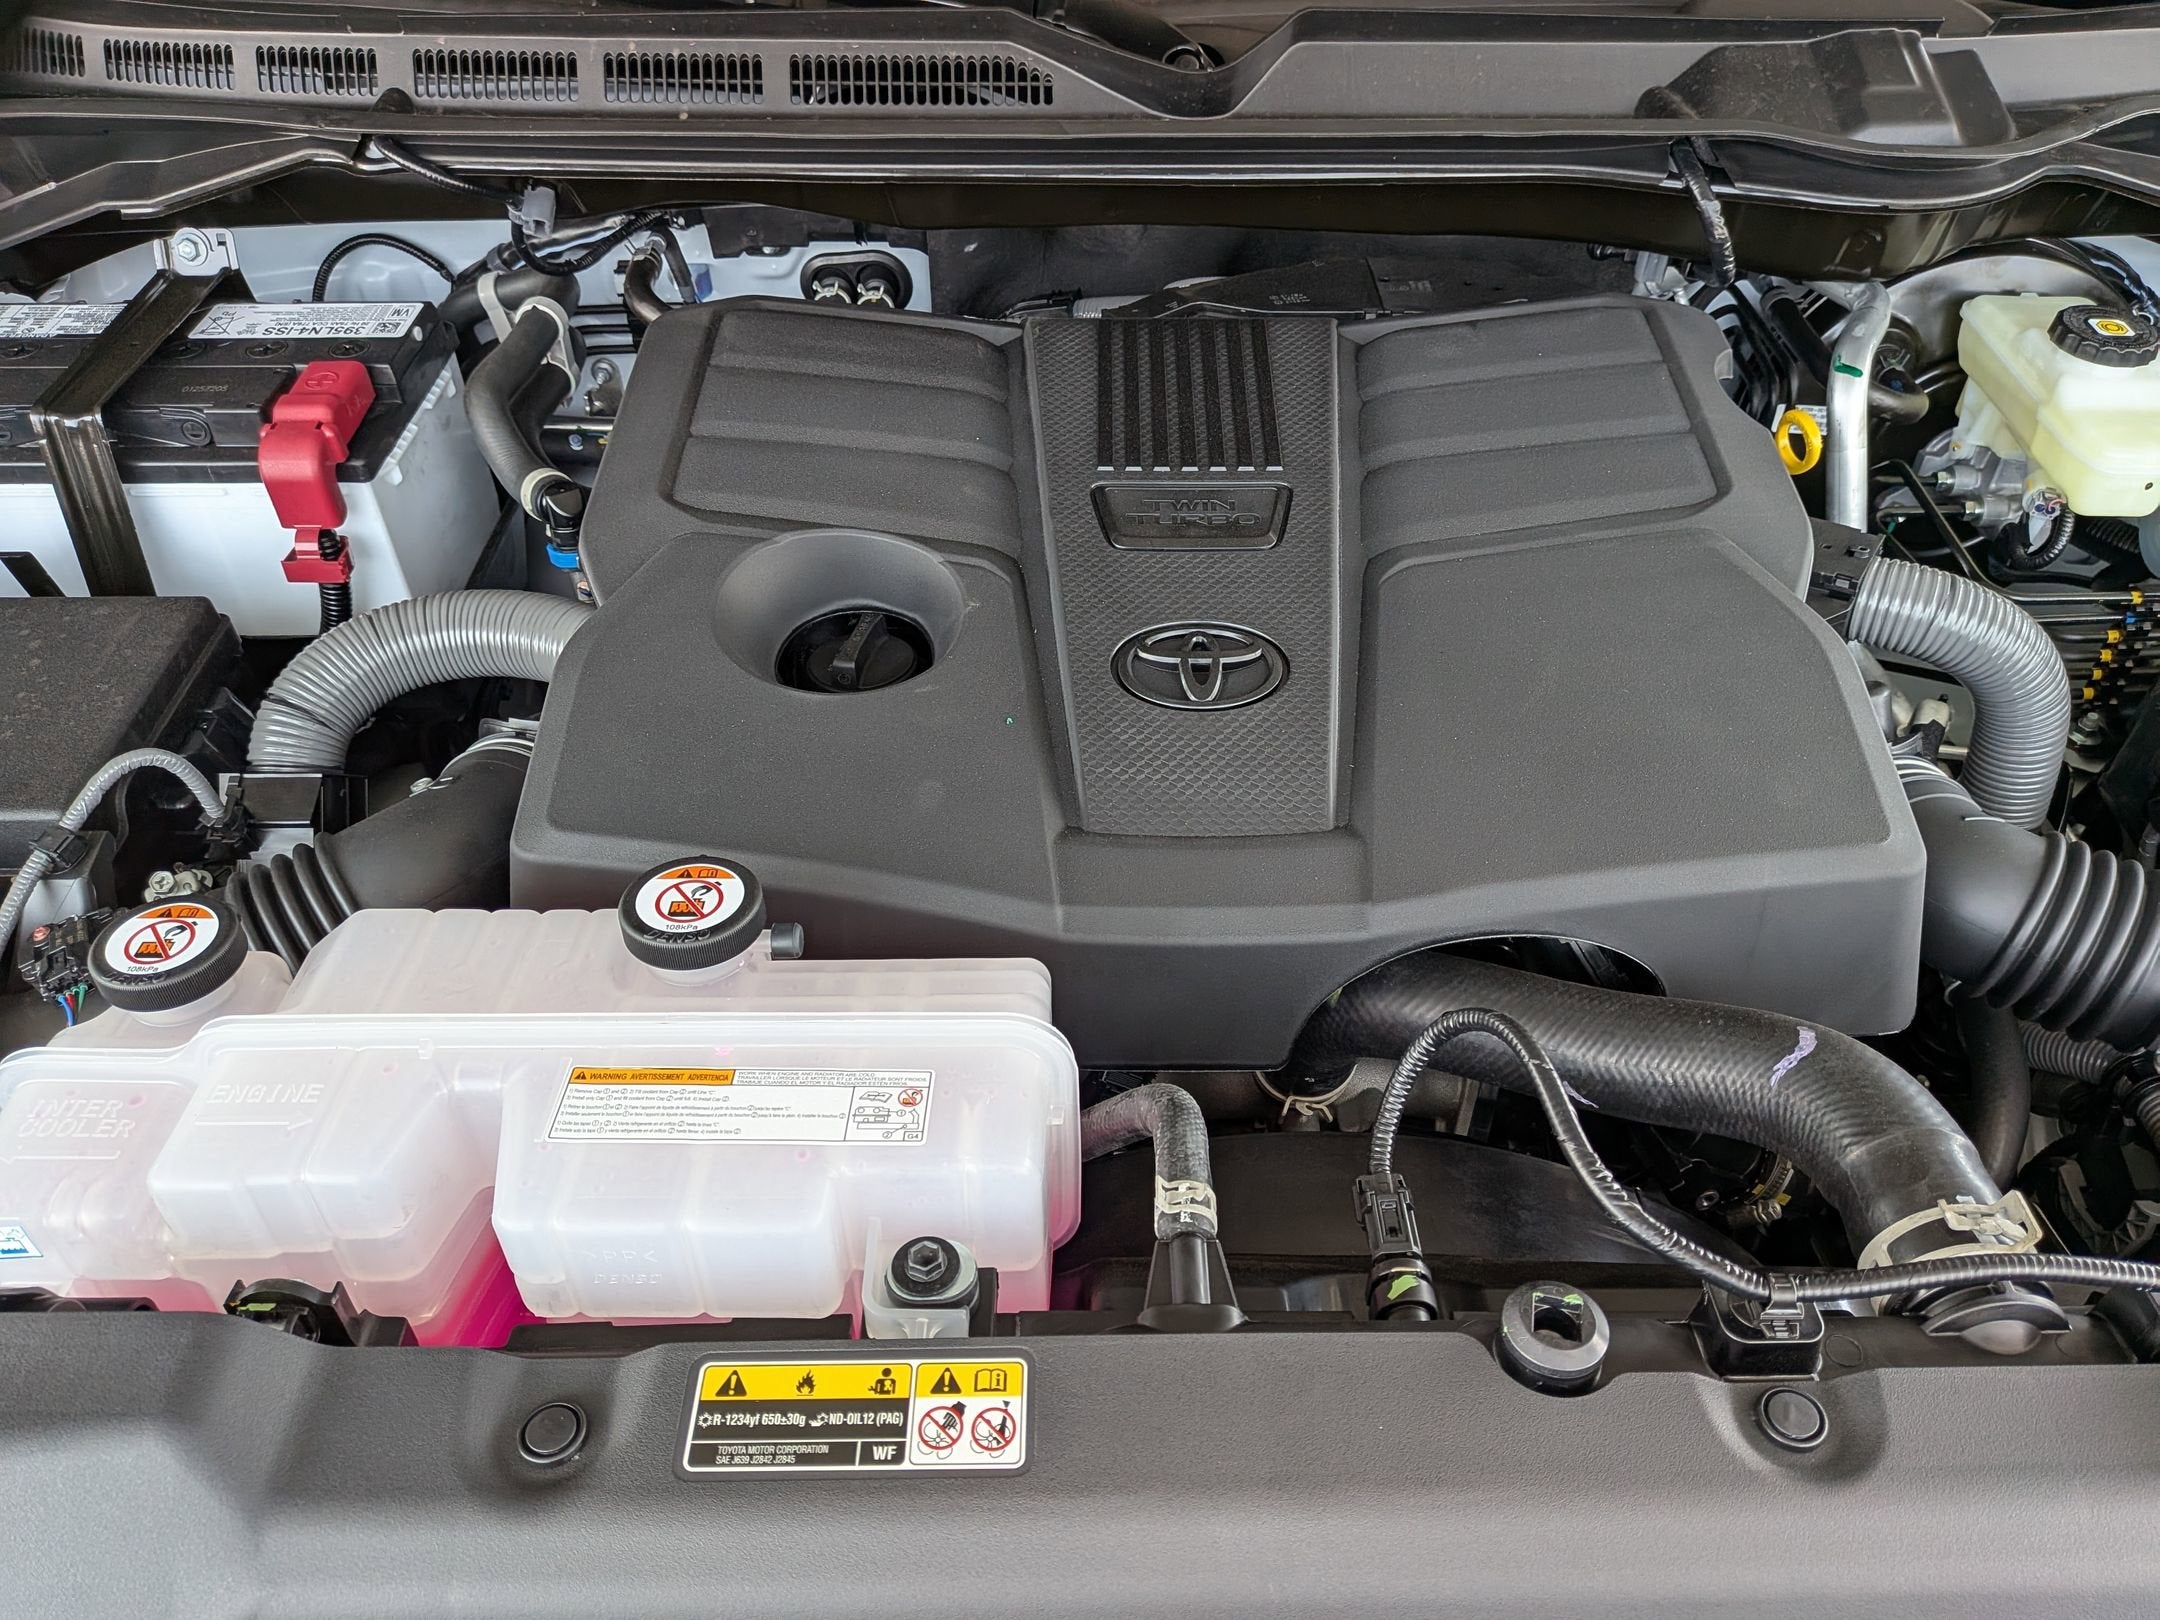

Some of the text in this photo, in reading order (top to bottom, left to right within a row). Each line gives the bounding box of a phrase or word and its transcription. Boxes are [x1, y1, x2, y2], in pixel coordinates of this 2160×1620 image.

[392, 308, 411, 317] VM
[261, 326, 367, 336] 395LN4-ISS
[1143, 499, 1237, 512] TWIN
[1126, 512, 1262, 527] TURBO
[664, 923, 699, 931] 108kPa
[643, 929, 712, 944] DENSO
[126, 965, 160, 973] 108kPa
[589, 1072, 730, 1082] WARNING AVERTISSEMENT ADVERTENCIA
[206, 1083, 325, 1104] ENGINE
[26, 1099, 127, 1119] INTER
[16, 1118, 136, 1139] COOLER
[712, 1413, 807, 1428] R-1234yf 650±30g
[829, 1411, 904, 1427] ND-OIL12 (PAG)
[717, 1444, 830, 1455] TOYOTA MOTOR CORPORATION
[872, 1445, 897, 1461] WF
[715, 1455, 796, 1465] SAE J639 J2842 J2845
